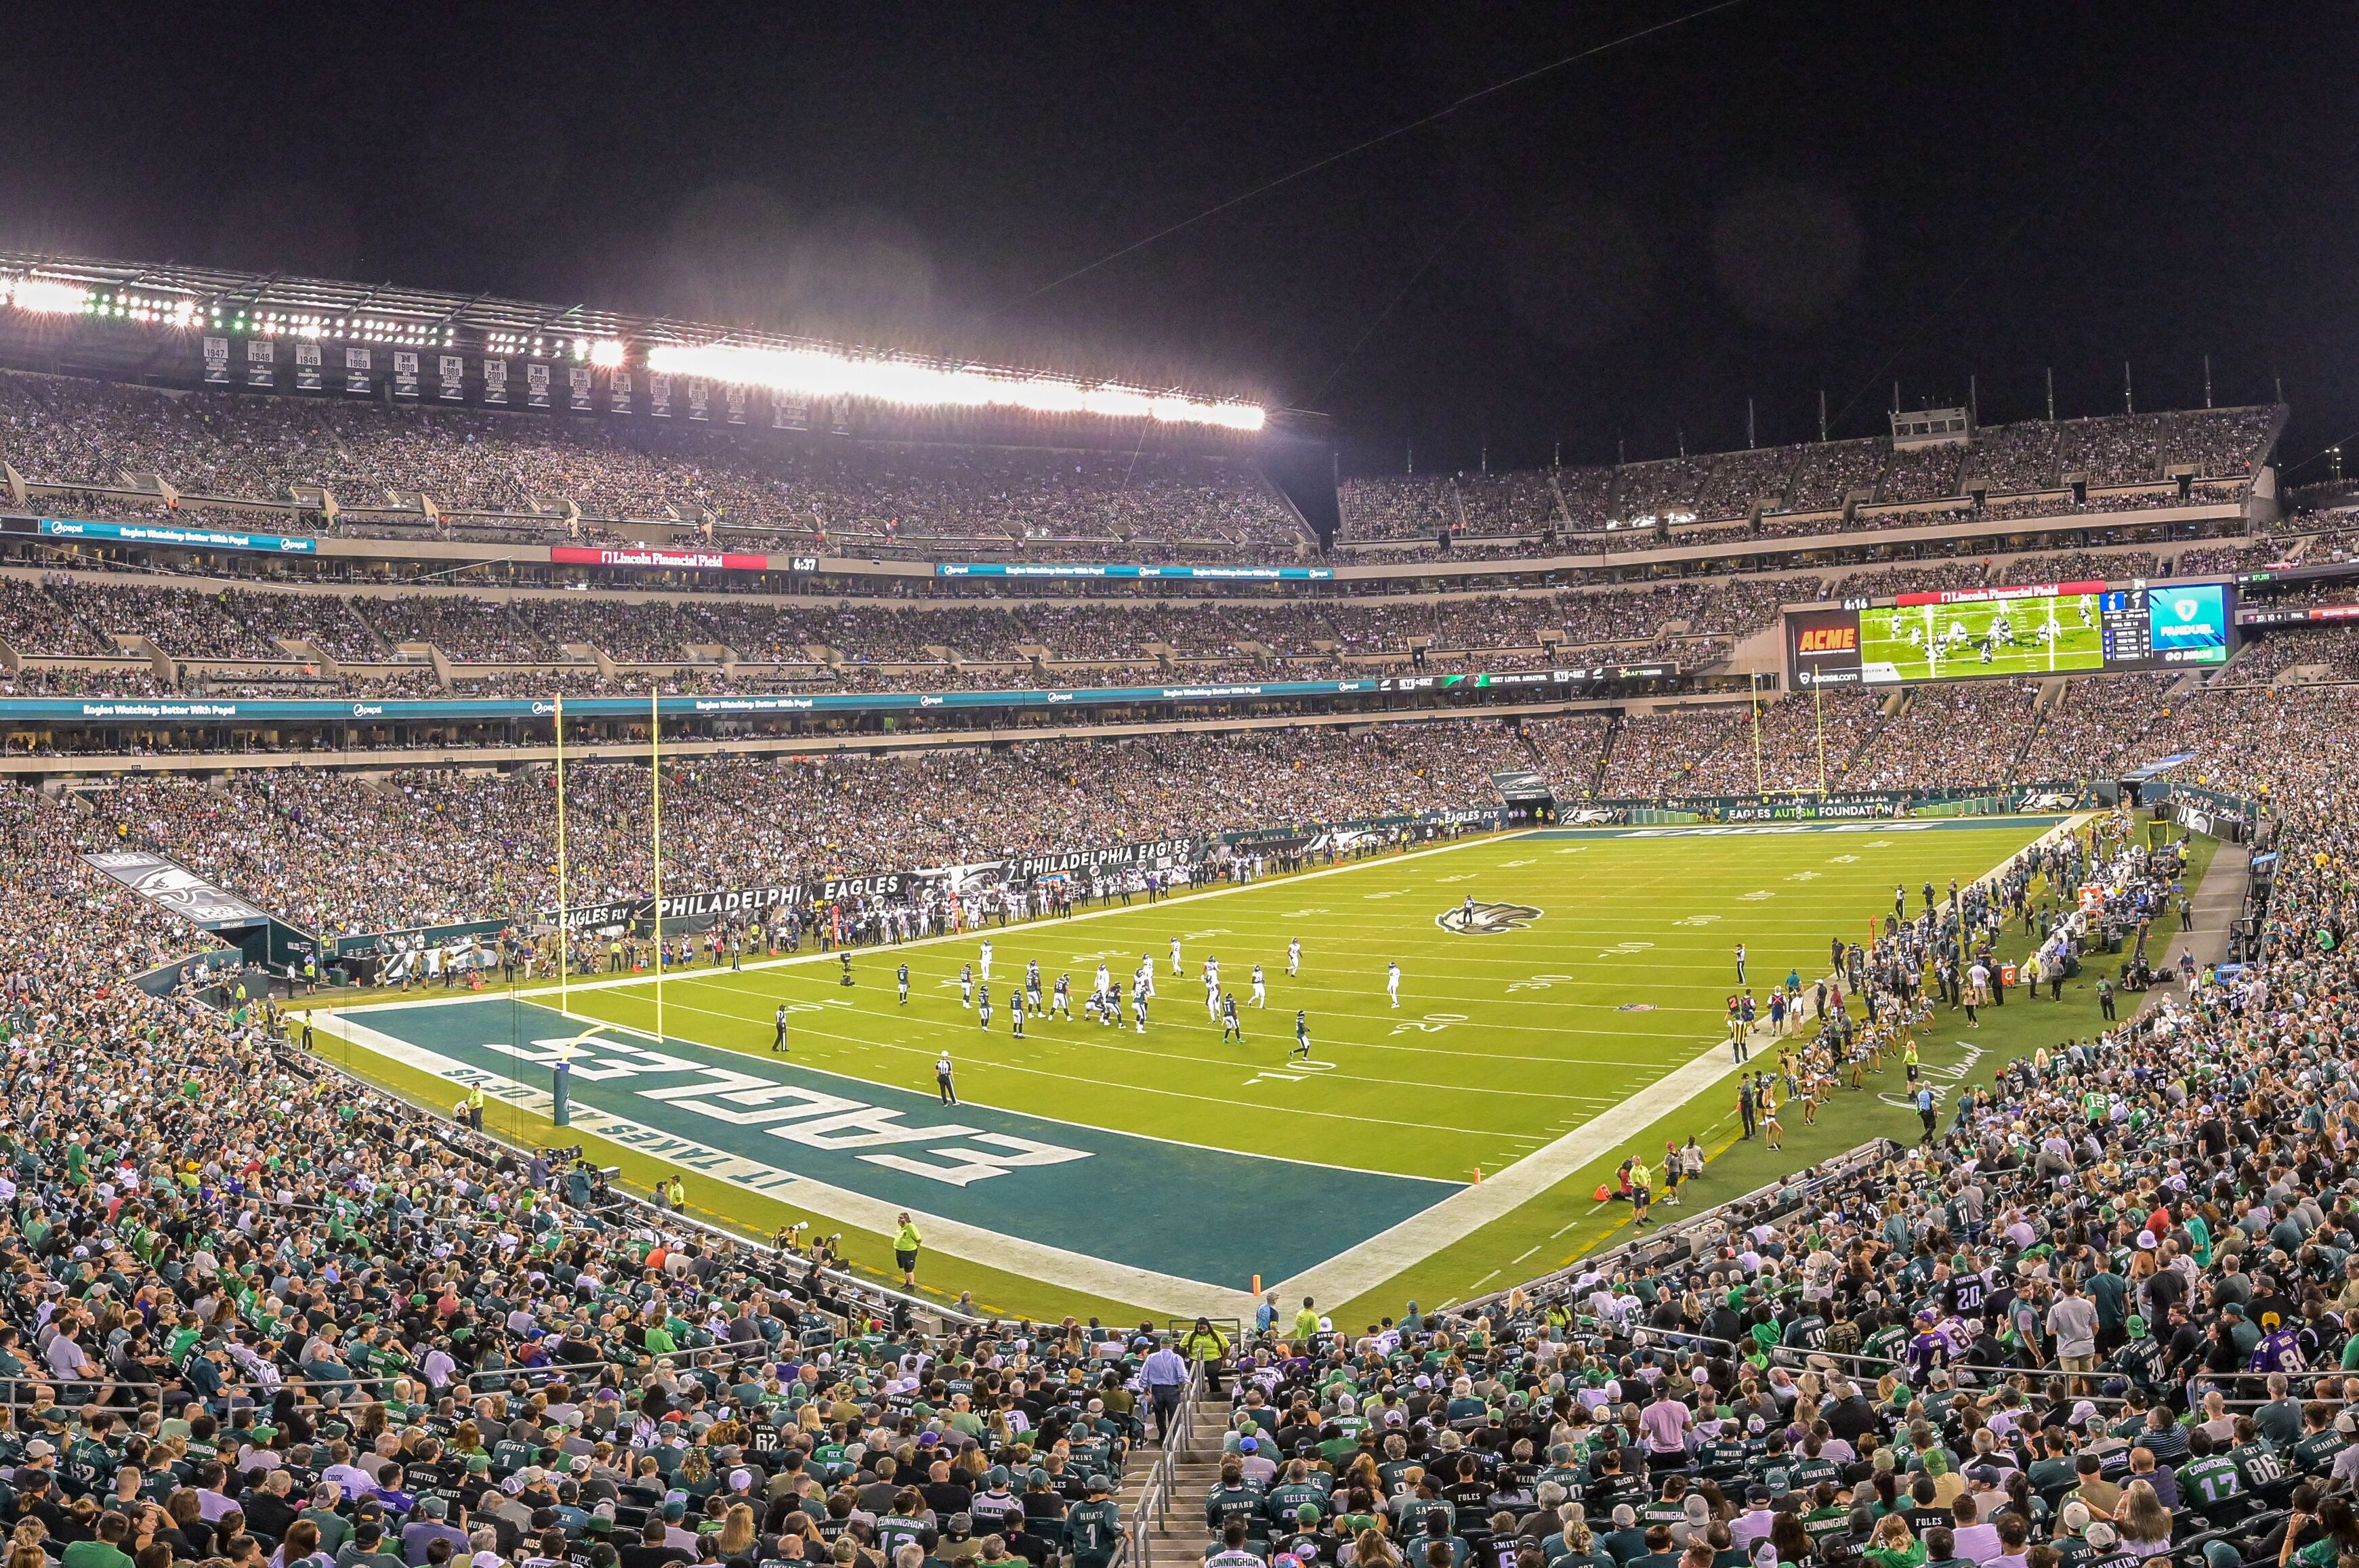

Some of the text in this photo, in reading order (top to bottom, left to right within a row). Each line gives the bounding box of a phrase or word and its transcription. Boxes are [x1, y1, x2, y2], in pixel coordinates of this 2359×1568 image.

[207, 349, 224, 358] 1947
[252, 353, 270, 361] 1948
[300, 356, 318, 364] 1949
[350, 359, 367, 368] 1960
[398, 364, 415, 372] 1980
[443, 367, 459, 376] 1988
[488, 371, 504, 380] 2001
[530, 375, 547, 383] 2002
[573, 379, 588, 387] 2003
[613, 383, 629, 391] 2004
[613, 551, 723, 567] Lincoln Financial Field
[794, 559, 816, 571] 6:37
[1952, 585, 2058, 601] Lincoln Financial Field
[1844, 598, 1867, 610] 6:16
[83, 705, 114, 716] Eagles
[161, 706, 189, 715] Better
[190, 705, 211, 714] With
[212, 705, 235, 716] Pepsi
[364, 706, 382, 715] pepsi
[1445, 810, 1479, 824] EAGLES
[1483, 810, 1499, 820] FLY
[1729, 805, 1893, 819] EAGLES AUTSM FOUNDATN
[1023, 838, 1190, 875] PHILADELPHIA EAGLES
[824, 876, 898, 900] EAGLES
[559, 908, 628, 929] EAGLES FLY
[1516, 974, 1573, 991] 30
[1224, 1004, 1231, 1012] 11
[1730, 998, 1738, 1007] 2
[1396, 1013, 1469, 1033] 20
[1257, 1060, 1337, 1083] 10
[2015, 1081, 2023, 1093] 20
[2155, 1078, 2166, 1090] 49
[2089, 1095, 2105, 1108] 12
[482, 1035, 1098, 1188] EAGLES
[440, 1068, 798, 1190] IT TAKES AL OF US
[1958, 1210, 1968, 1225] 11
[1955, 1274, 1979, 1285] DAWKINS
[1957, 1286, 1981, 1310] 20
[1626, 1306, 1645, 1326] 92
[1801, 1319, 1821, 1328] JACKSON
[1805, 1329, 1826, 1348] 10
[1950, 1327, 1967, 1349] 8
[2278, 1335, 2292, 1346] MOSS
[1885, 1340, 1906, 1360] 12
[2255, 1341, 2268, 1352] 84
[182, 1354, 192, 1374] 6
[1931, 1350, 1942, 1369] 4
[2279, 1344, 2307, 1373] 84
[2146, 1355, 2165, 1383] 20
[500, 1442, 526, 1453] HURTS
[756, 1434, 777, 1452] 62
[2242, 1444, 2262, 1456] ERTZ
[2189, 1457, 2233, 1476] CARMICHAEL
[2245, 1454, 2280, 1485] 86
[409, 1470, 438, 1484] TROTTER
[1802, 1468, 1835, 1480] DAWKINS
[1614, 1476, 1634, 1486] McCOY
[2201, 1472, 2237, 1501] 17
[437, 1488, 461, 1499] HURTS
[1284, 1493, 1311, 1503] CELEK
[977, 1505, 1007, 1516] DAWKIN
[1221, 1500, 1254, 1510] HOWARD
[1080, 1511, 1104, 1520] HURTS
[1645, 1511, 1687, 1520] CUNNINGHA
[1916, 1517, 1942, 1526] FOLES
[877, 1518, 925, 1530] CUNNINGHAM
[1804, 1516, 1851, 1532] CUNNINGHA
[1086, 1523, 1097, 1549] 1
[523, 1538, 541, 1548] MOS
[571, 1554, 589, 1566] VICK
[1210, 1556, 1258, 1567] CUNNINGHAM
